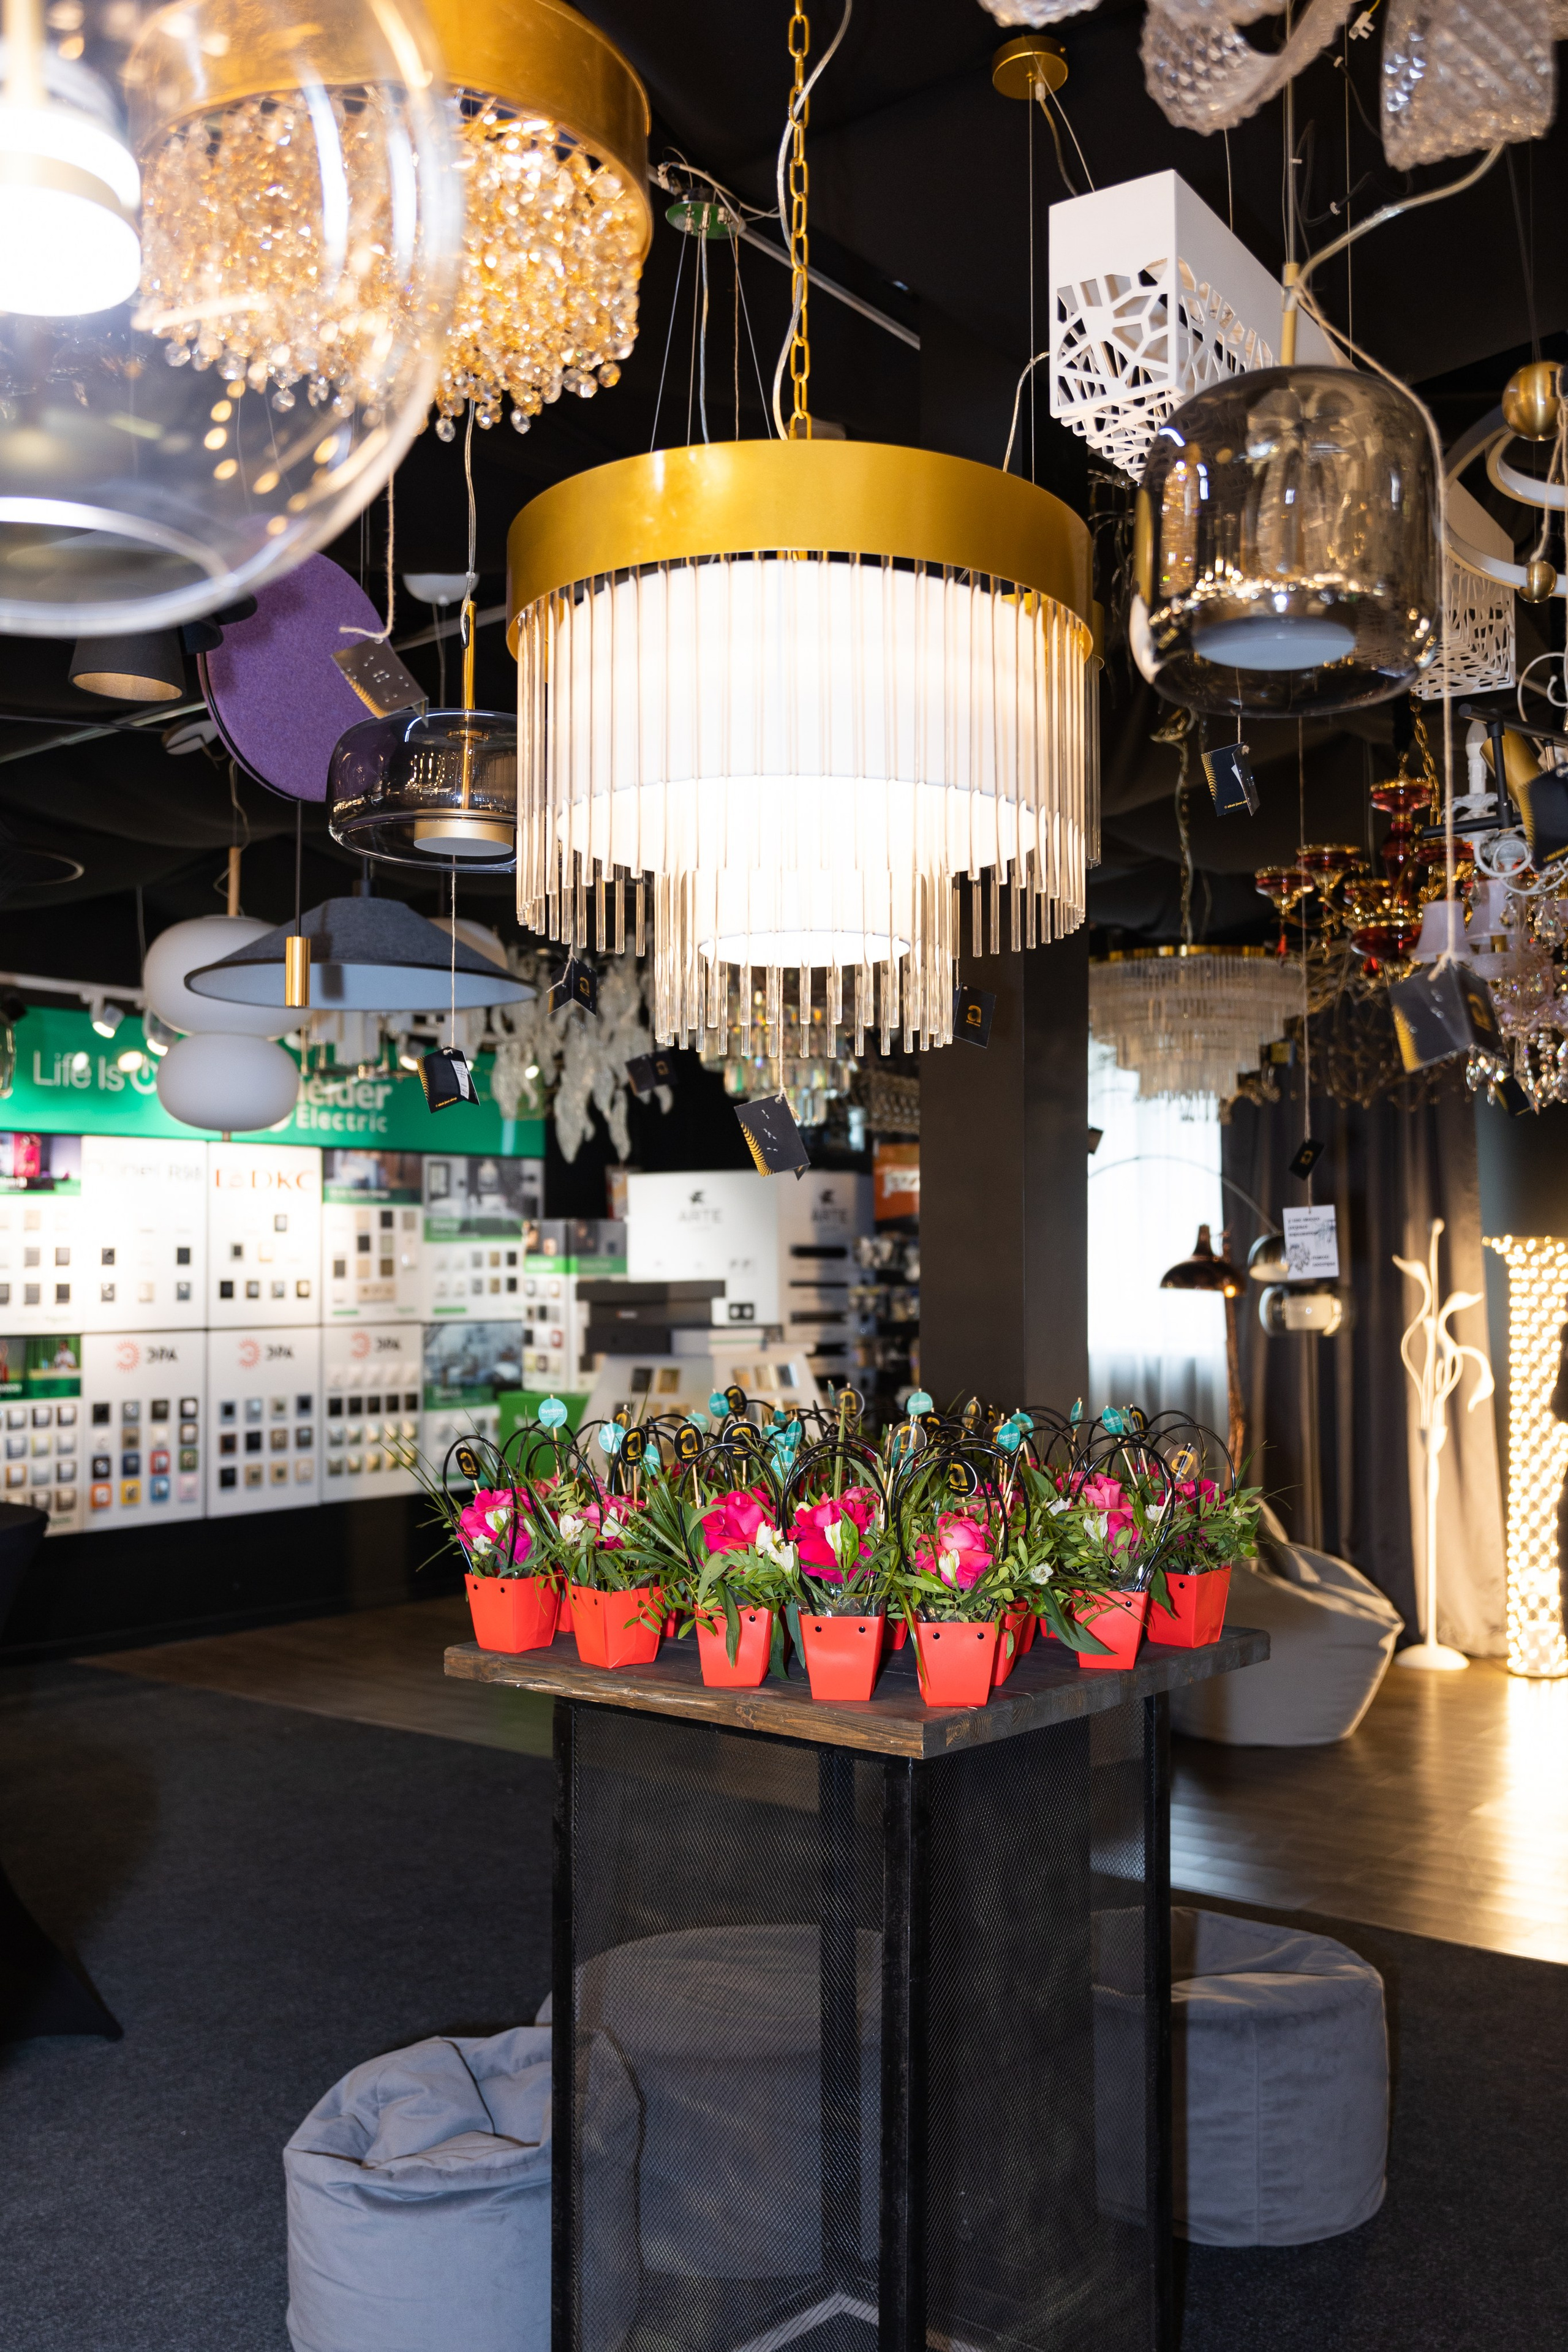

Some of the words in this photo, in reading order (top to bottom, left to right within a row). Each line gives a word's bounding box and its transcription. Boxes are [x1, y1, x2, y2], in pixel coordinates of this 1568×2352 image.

[33, 1050, 91, 1089] Life
[98, 1055, 126, 1092] Is
[296, 1105, 388, 1133] Electric
[679, 1208, 722, 1223] ARTE
[811, 1208, 848, 1224] ARTE
